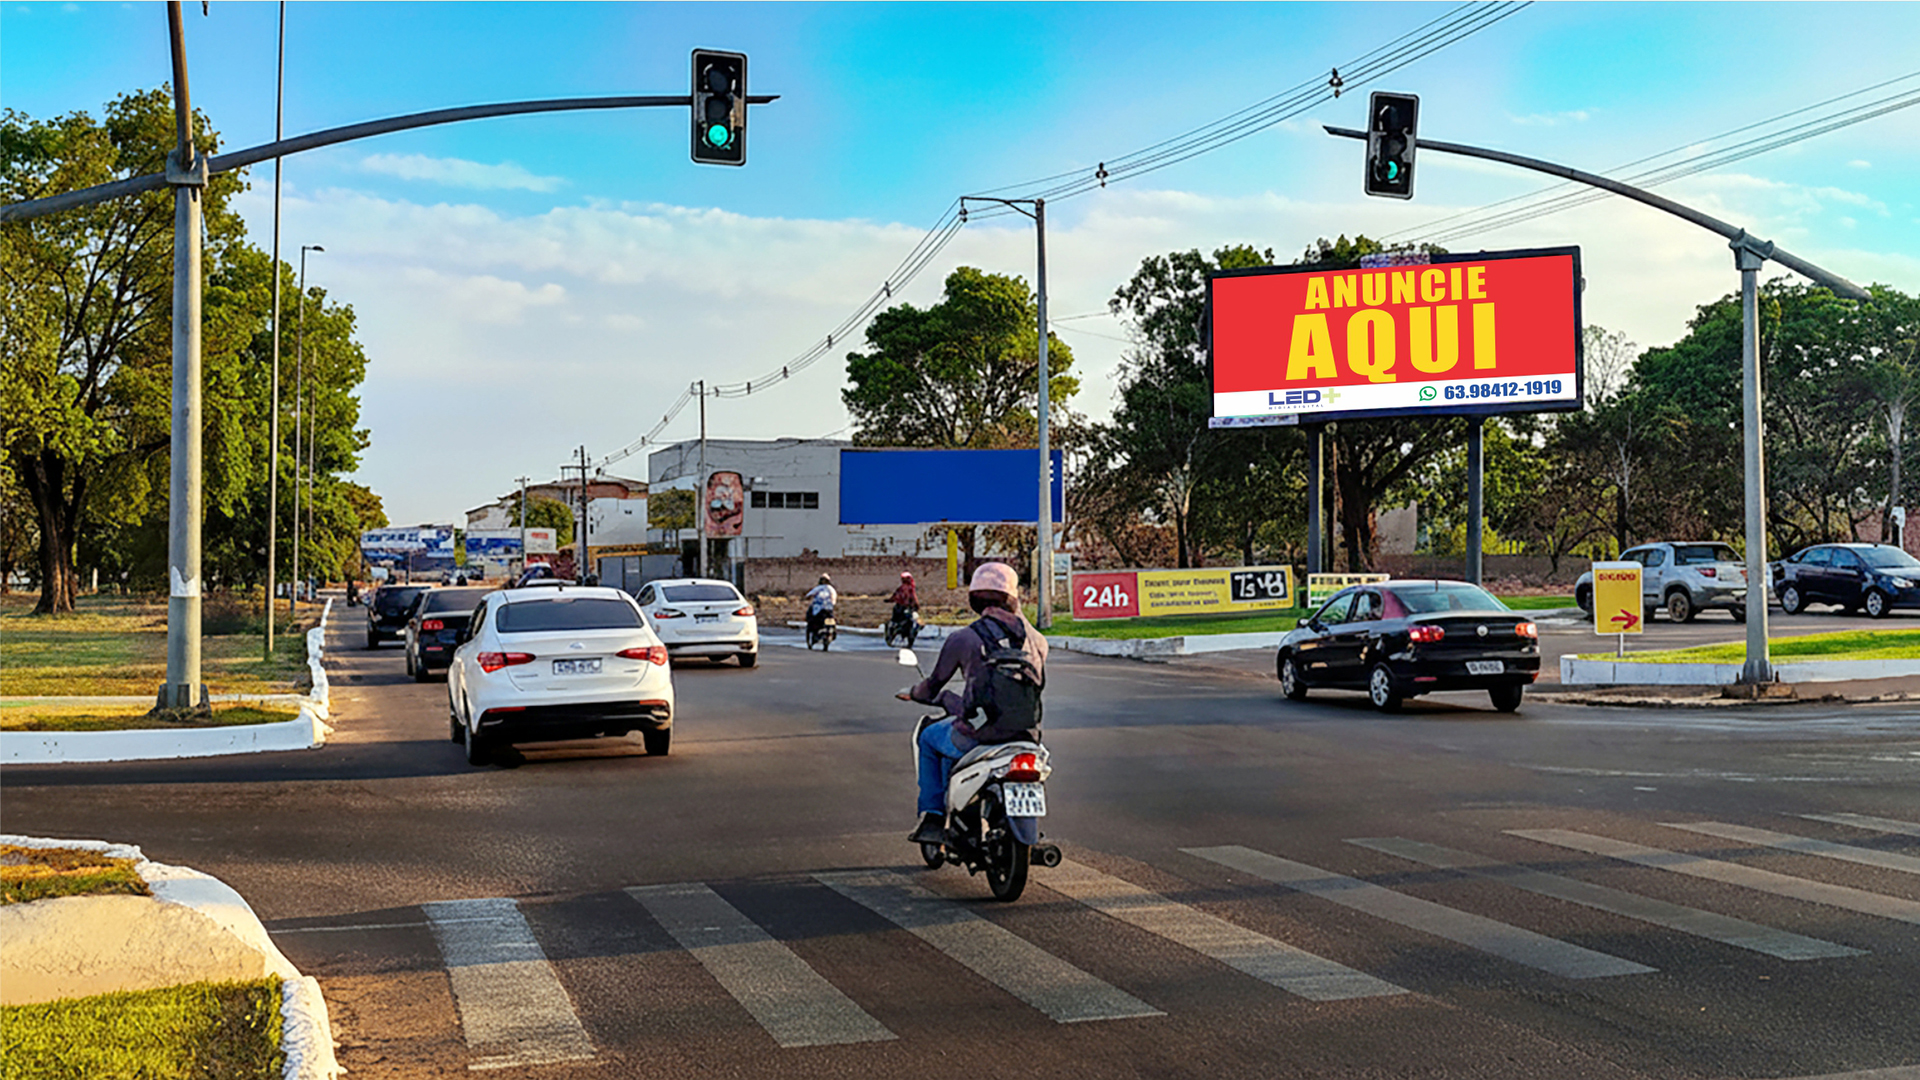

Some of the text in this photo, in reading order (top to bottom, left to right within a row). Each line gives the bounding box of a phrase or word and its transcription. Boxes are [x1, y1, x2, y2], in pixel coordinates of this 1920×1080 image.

[1305, 265, 1487, 310] ANUNCIE
[1286, 302, 1497, 383] AQUI
[1444, 379, 1562, 400] 63.98412-1919
